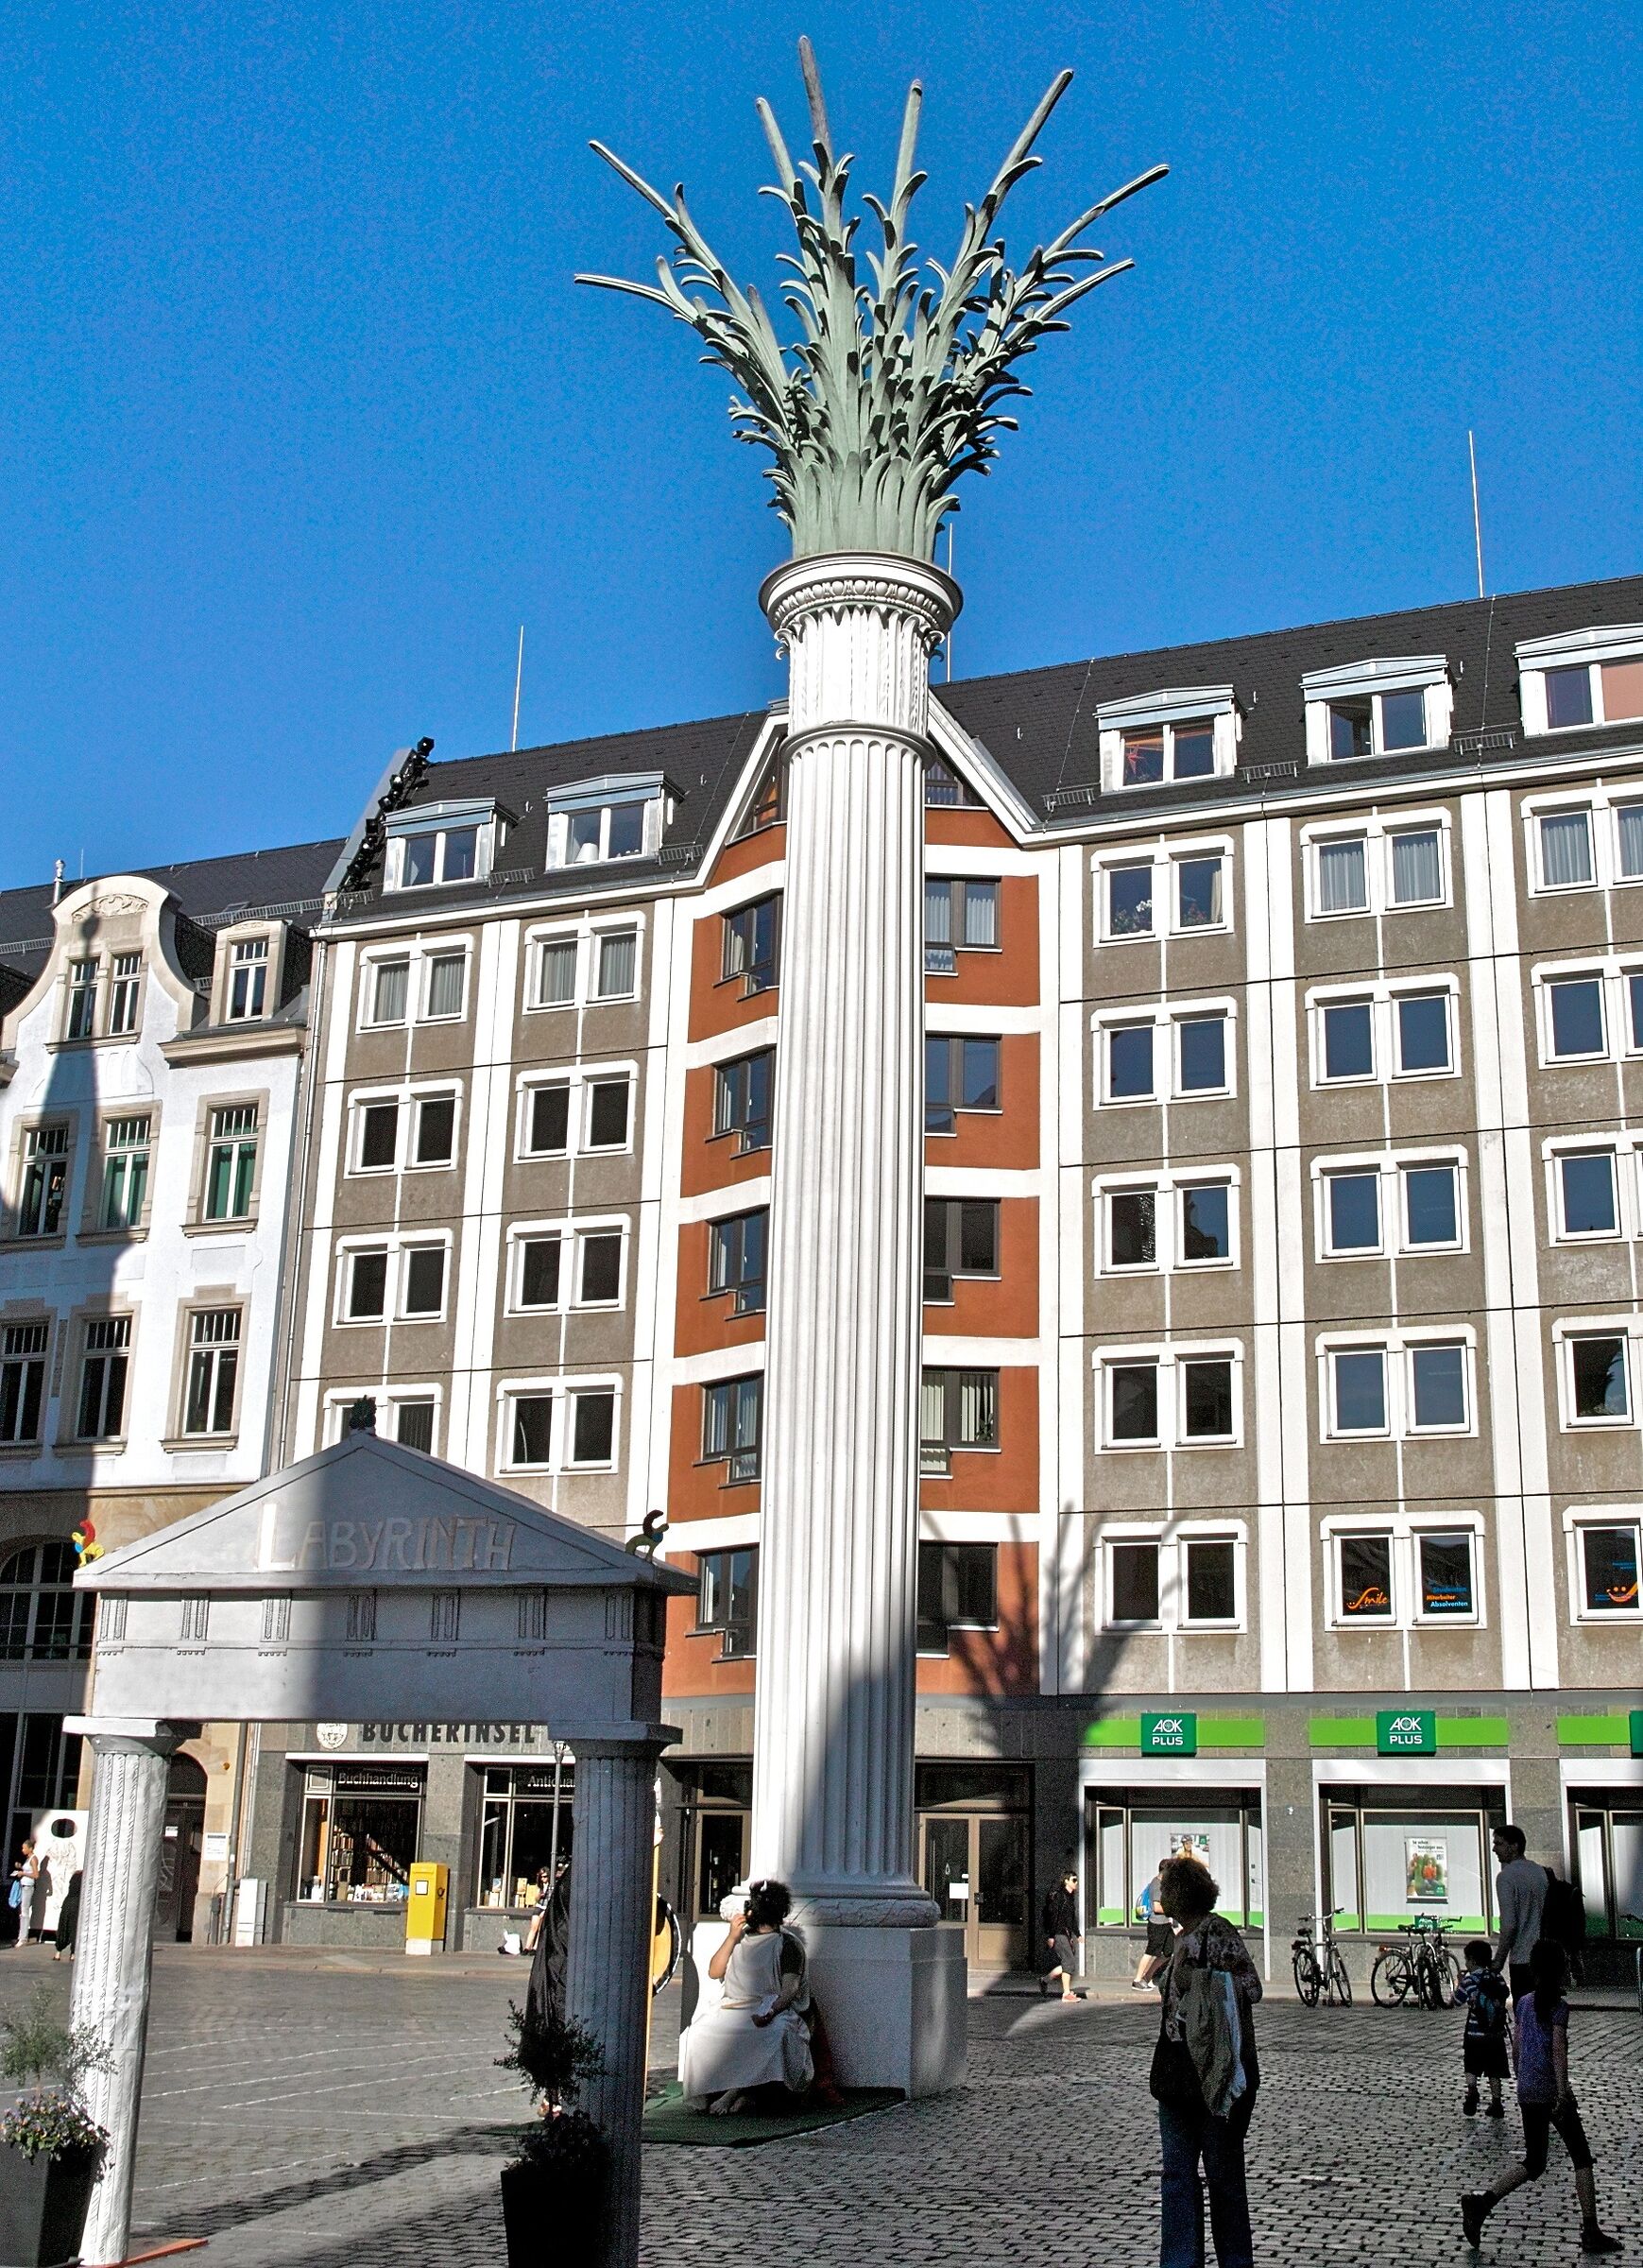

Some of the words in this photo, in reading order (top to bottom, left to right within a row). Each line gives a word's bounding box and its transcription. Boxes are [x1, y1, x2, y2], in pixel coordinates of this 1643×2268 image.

[1152, 1719, 1183, 1733] AOK
[1389, 1717, 1422, 1731] AOK
[1152, 1736, 1184, 1745] PLUS
[1389, 1735, 1423, 1744] PLUS
[337, 1772, 419, 1789] Buchhandlung
